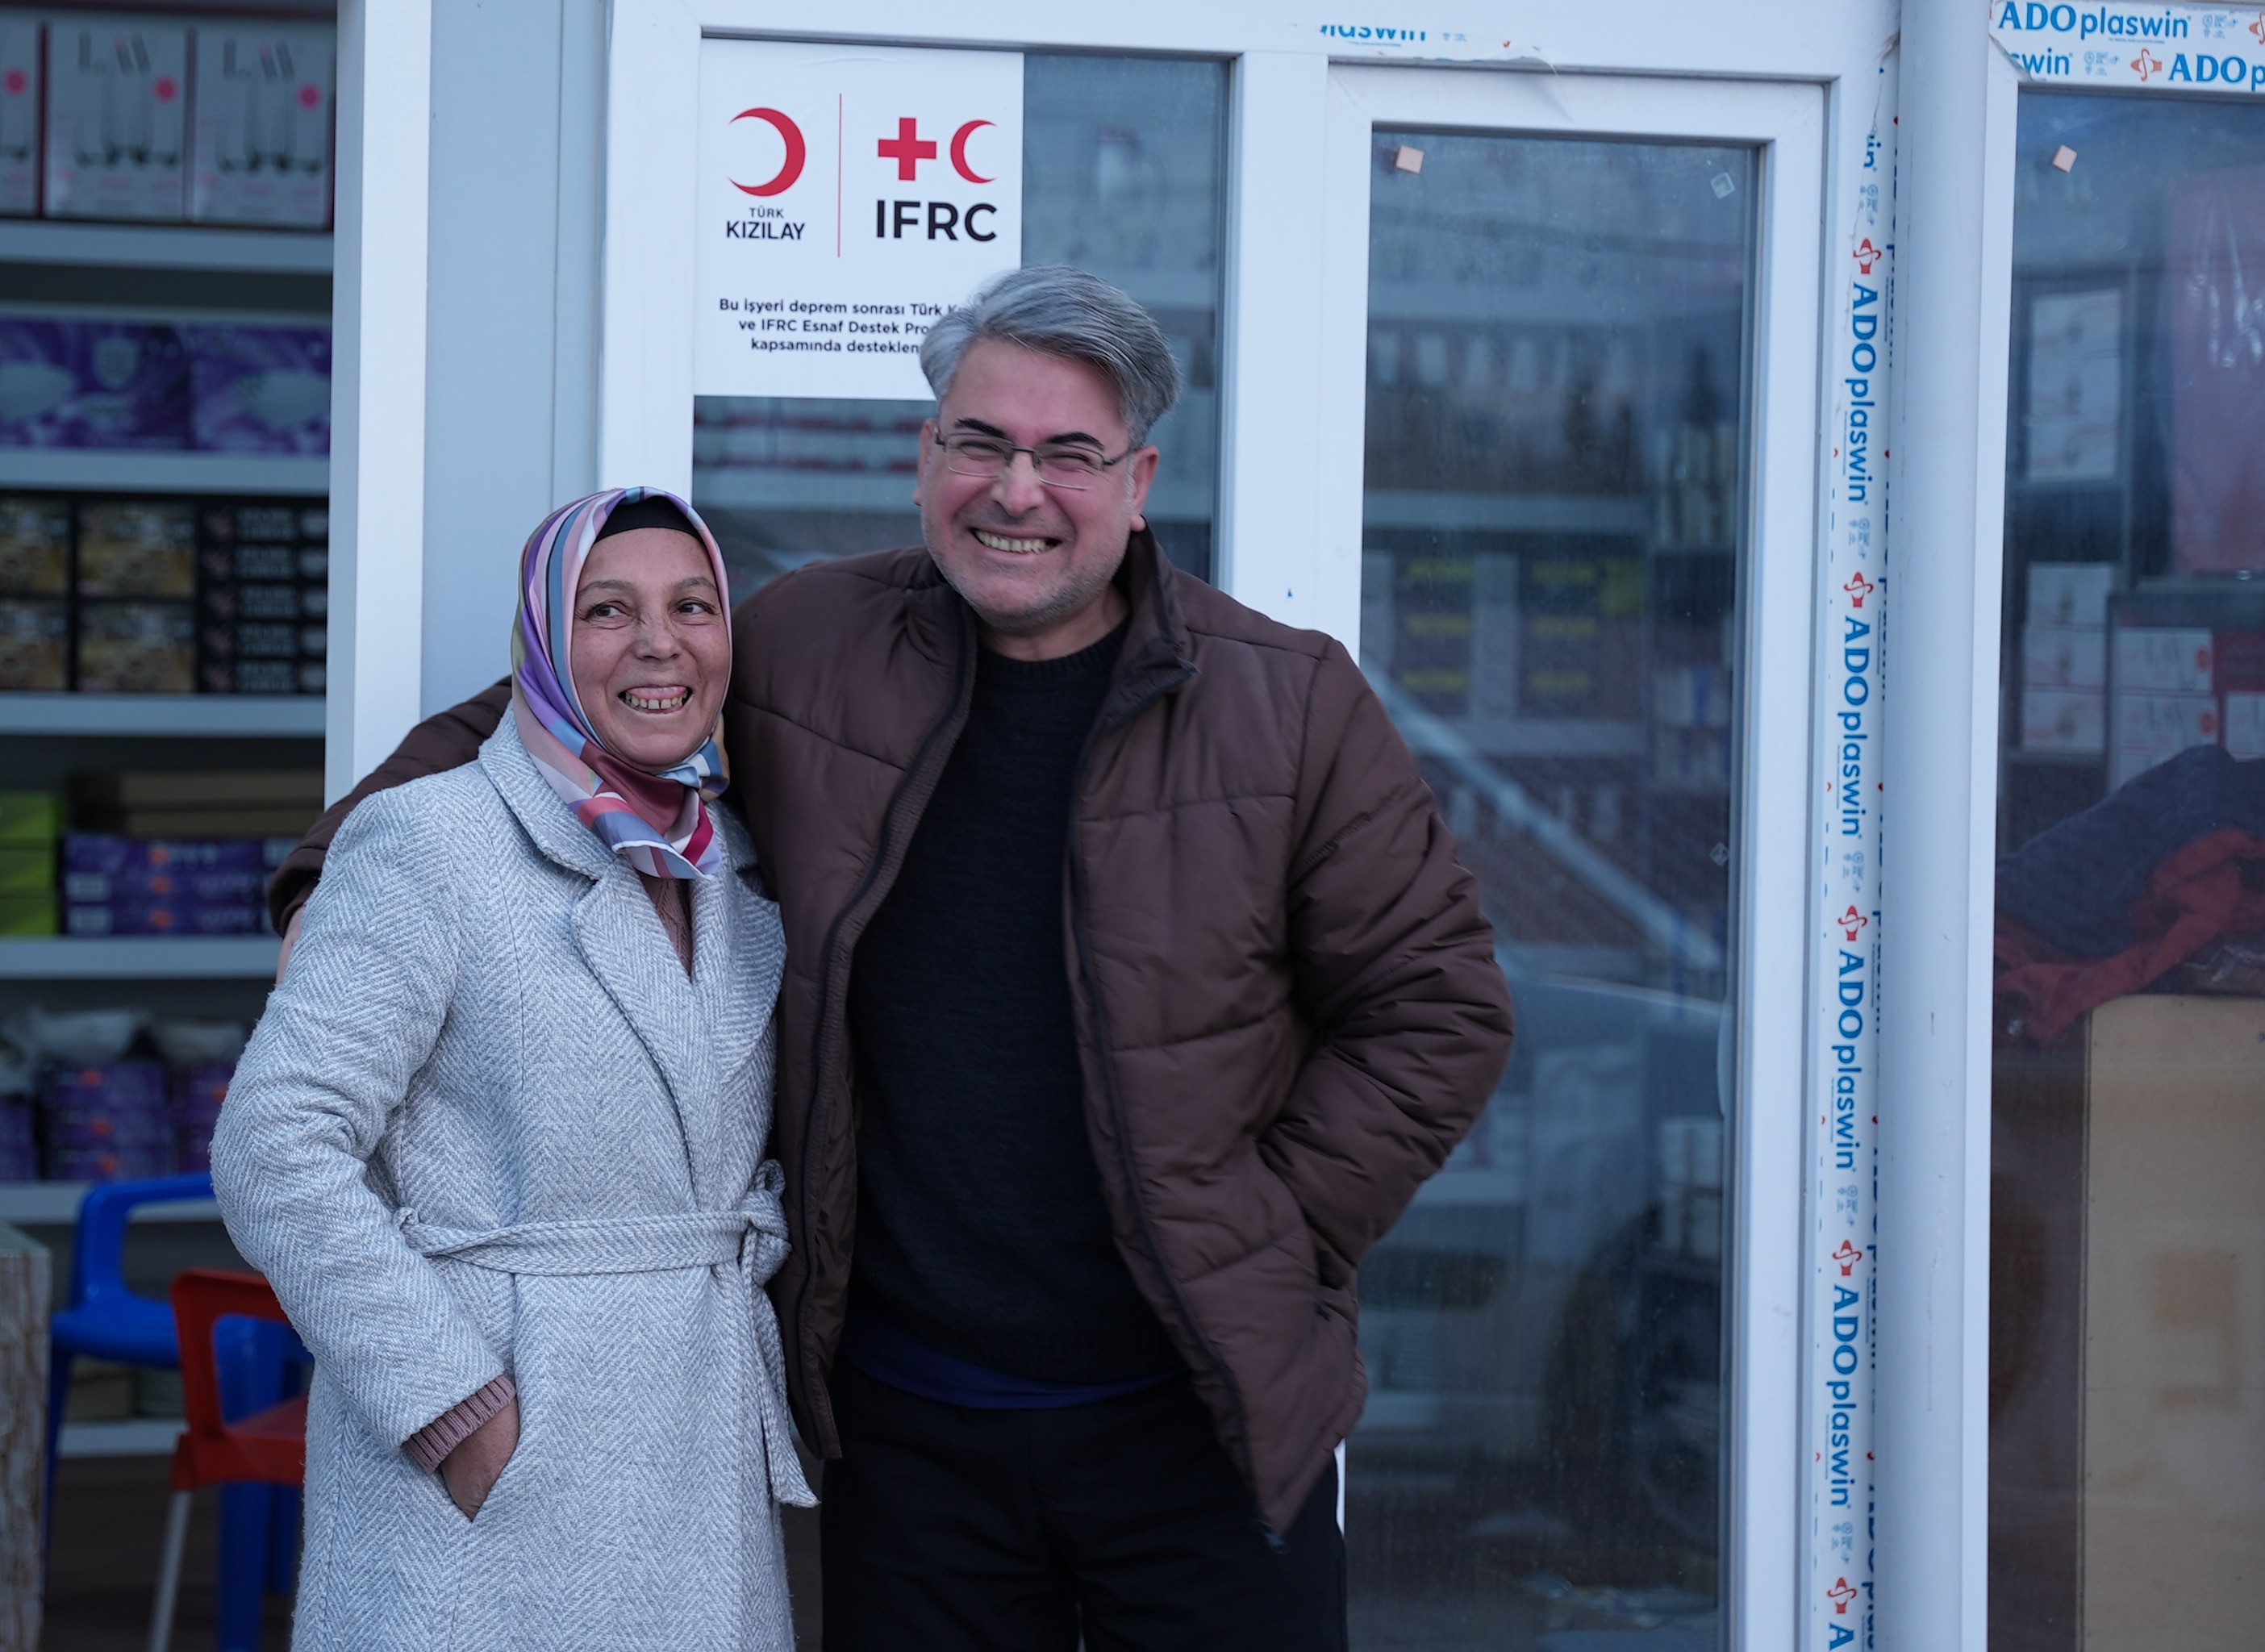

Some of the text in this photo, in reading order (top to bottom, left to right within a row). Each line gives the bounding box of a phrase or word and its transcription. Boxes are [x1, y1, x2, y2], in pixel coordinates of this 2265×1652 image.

[749, 204, 784, 219] TÜRK
[876, 199, 999, 242] IFRC
[726, 221, 805, 240] KIZILAY
[720, 298, 739, 311] Bu
[744, 298, 784, 314] işyeri
[789, 300, 847, 315] deprem
[853, 304, 905, 315] sonrası
[911, 303, 942, 315] Türk
[739, 319, 929, 334] ve IFRC Esnaf Destek Pro
[751, 337, 920, 353] kapsamında desteklen
